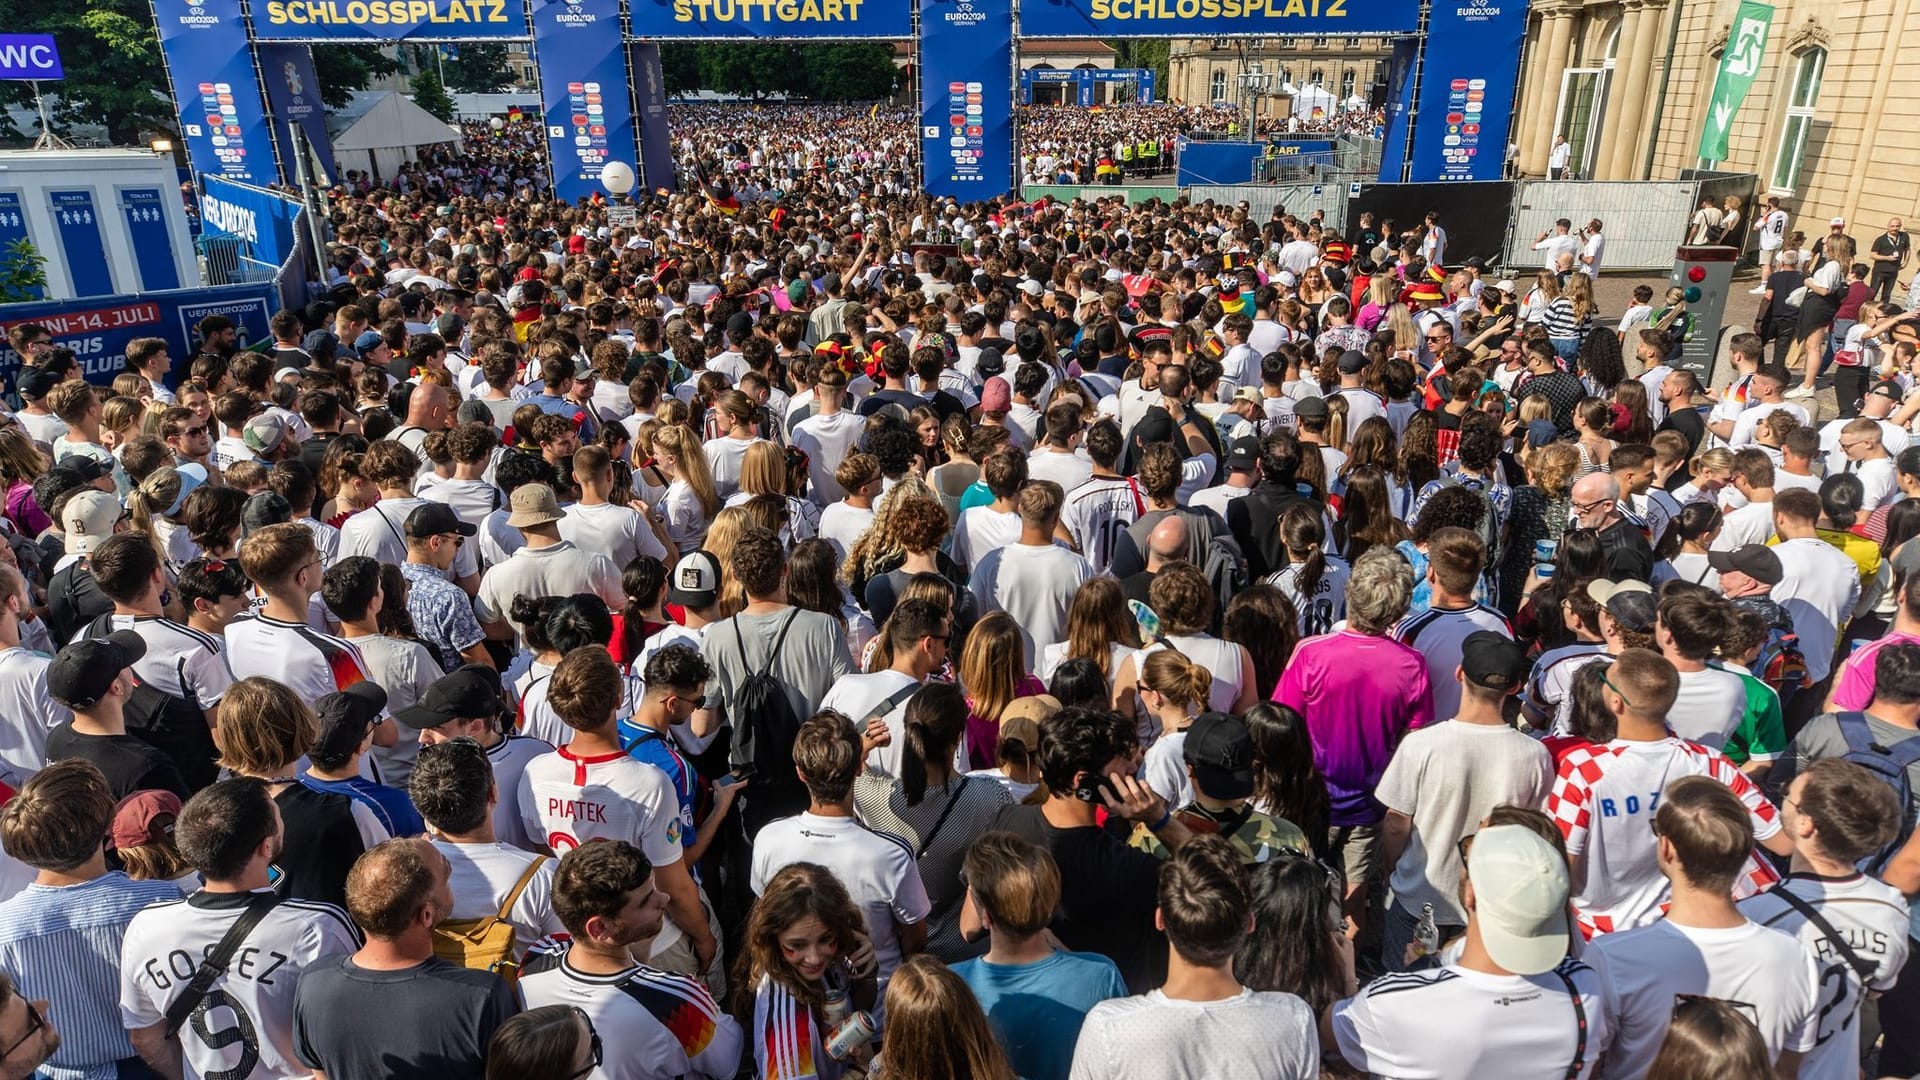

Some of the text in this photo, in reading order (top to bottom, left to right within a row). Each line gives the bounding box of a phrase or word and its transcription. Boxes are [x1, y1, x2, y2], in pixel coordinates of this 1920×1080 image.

[180, 16, 219, 24] EURO2024
[267, 0, 508, 25] SCHLOSSPLATZ
[556, 14, 596, 22] EURO2024
[673, 0, 864, 21] STUTTGART
[945, 12, 986, 21] EURO2024
[1090, 0, 1348, 20] SCHLOSSPLATZ
[1457, 8, 1500, 16] EURO2024
[0, 45, 54, 68] WC
[1279, 146, 1300, 155] ART
[111, 306, 154, 326] JULI
[72, 518, 85, 534] B
[250, 597, 269, 607] SCH
[548, 797, 608, 824] PIĄTEK
[1814, 928, 1889, 963] RUS
[190, 988, 260, 1080] 9
